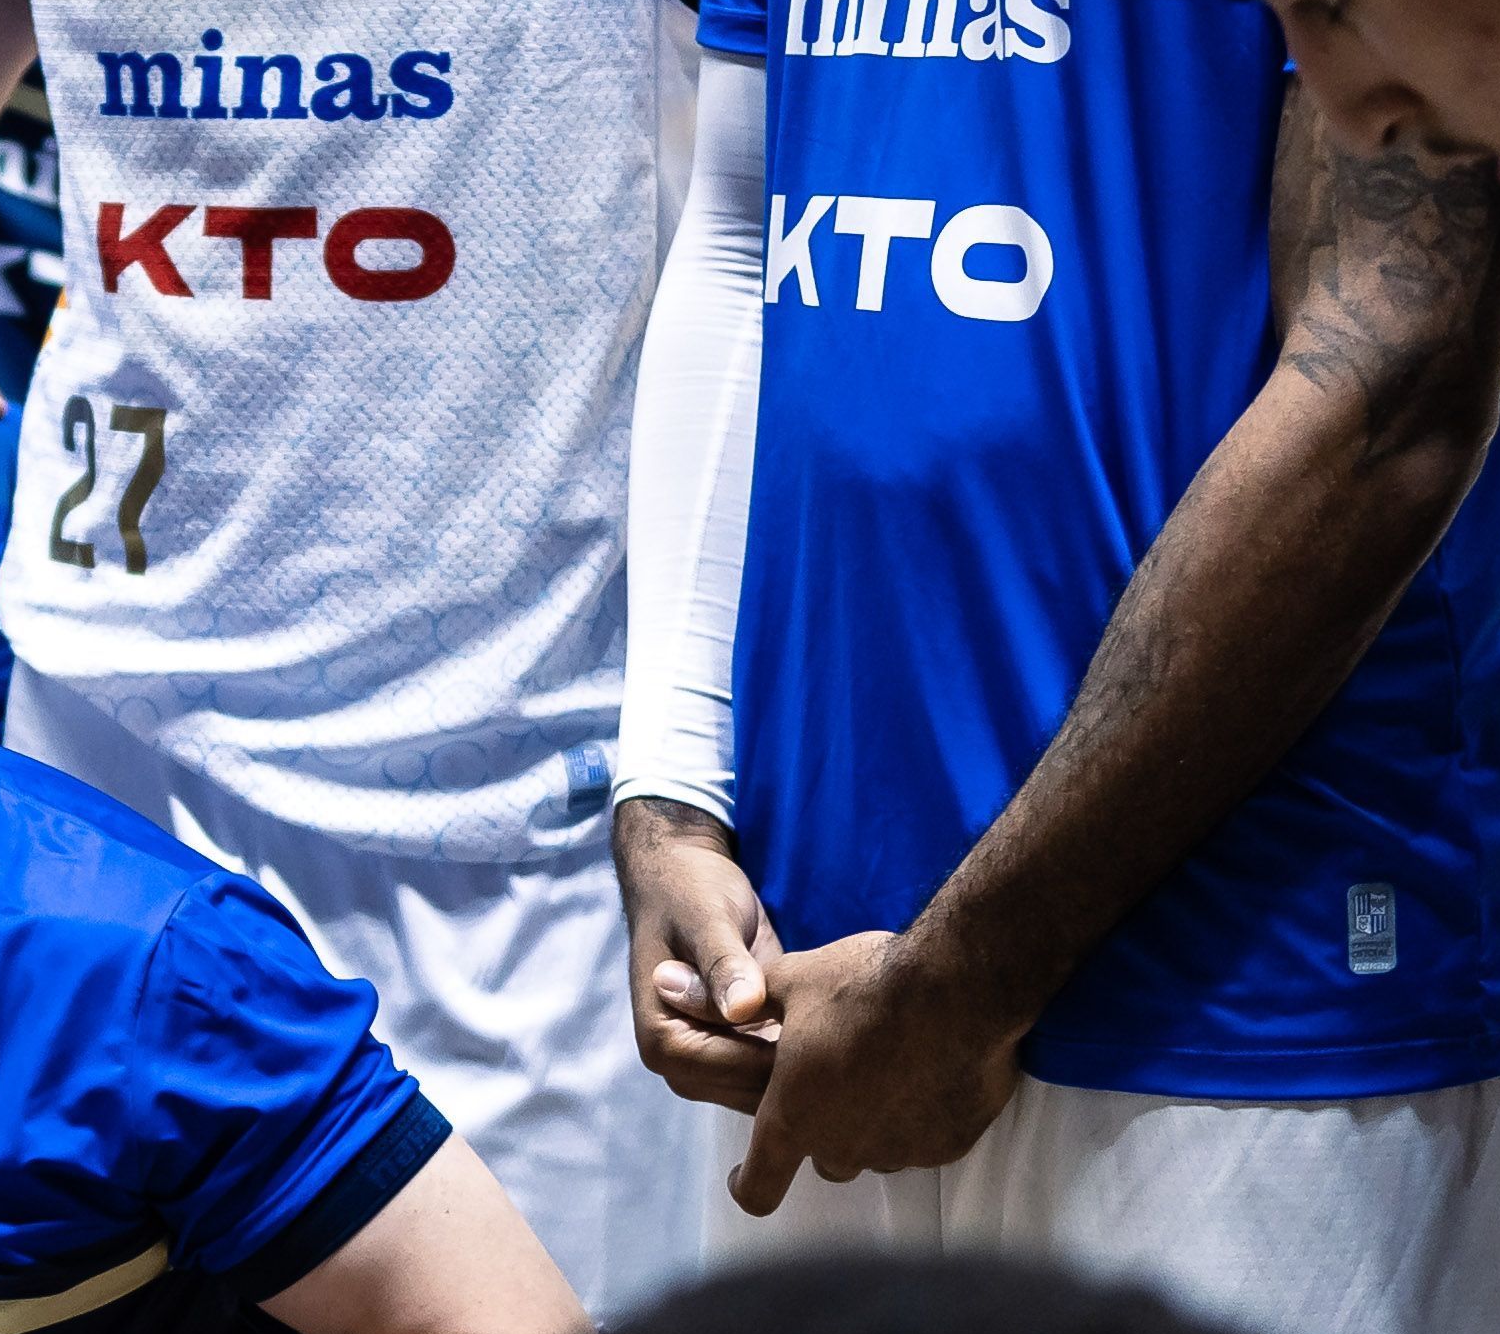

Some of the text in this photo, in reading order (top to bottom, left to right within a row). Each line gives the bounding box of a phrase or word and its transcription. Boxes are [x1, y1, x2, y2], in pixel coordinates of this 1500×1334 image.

[99, 28, 455, 123] minas
[97, 202, 456, 302] KTO
[764, 194, 1054, 322] KTO
[49, 395, 167, 575] 27
